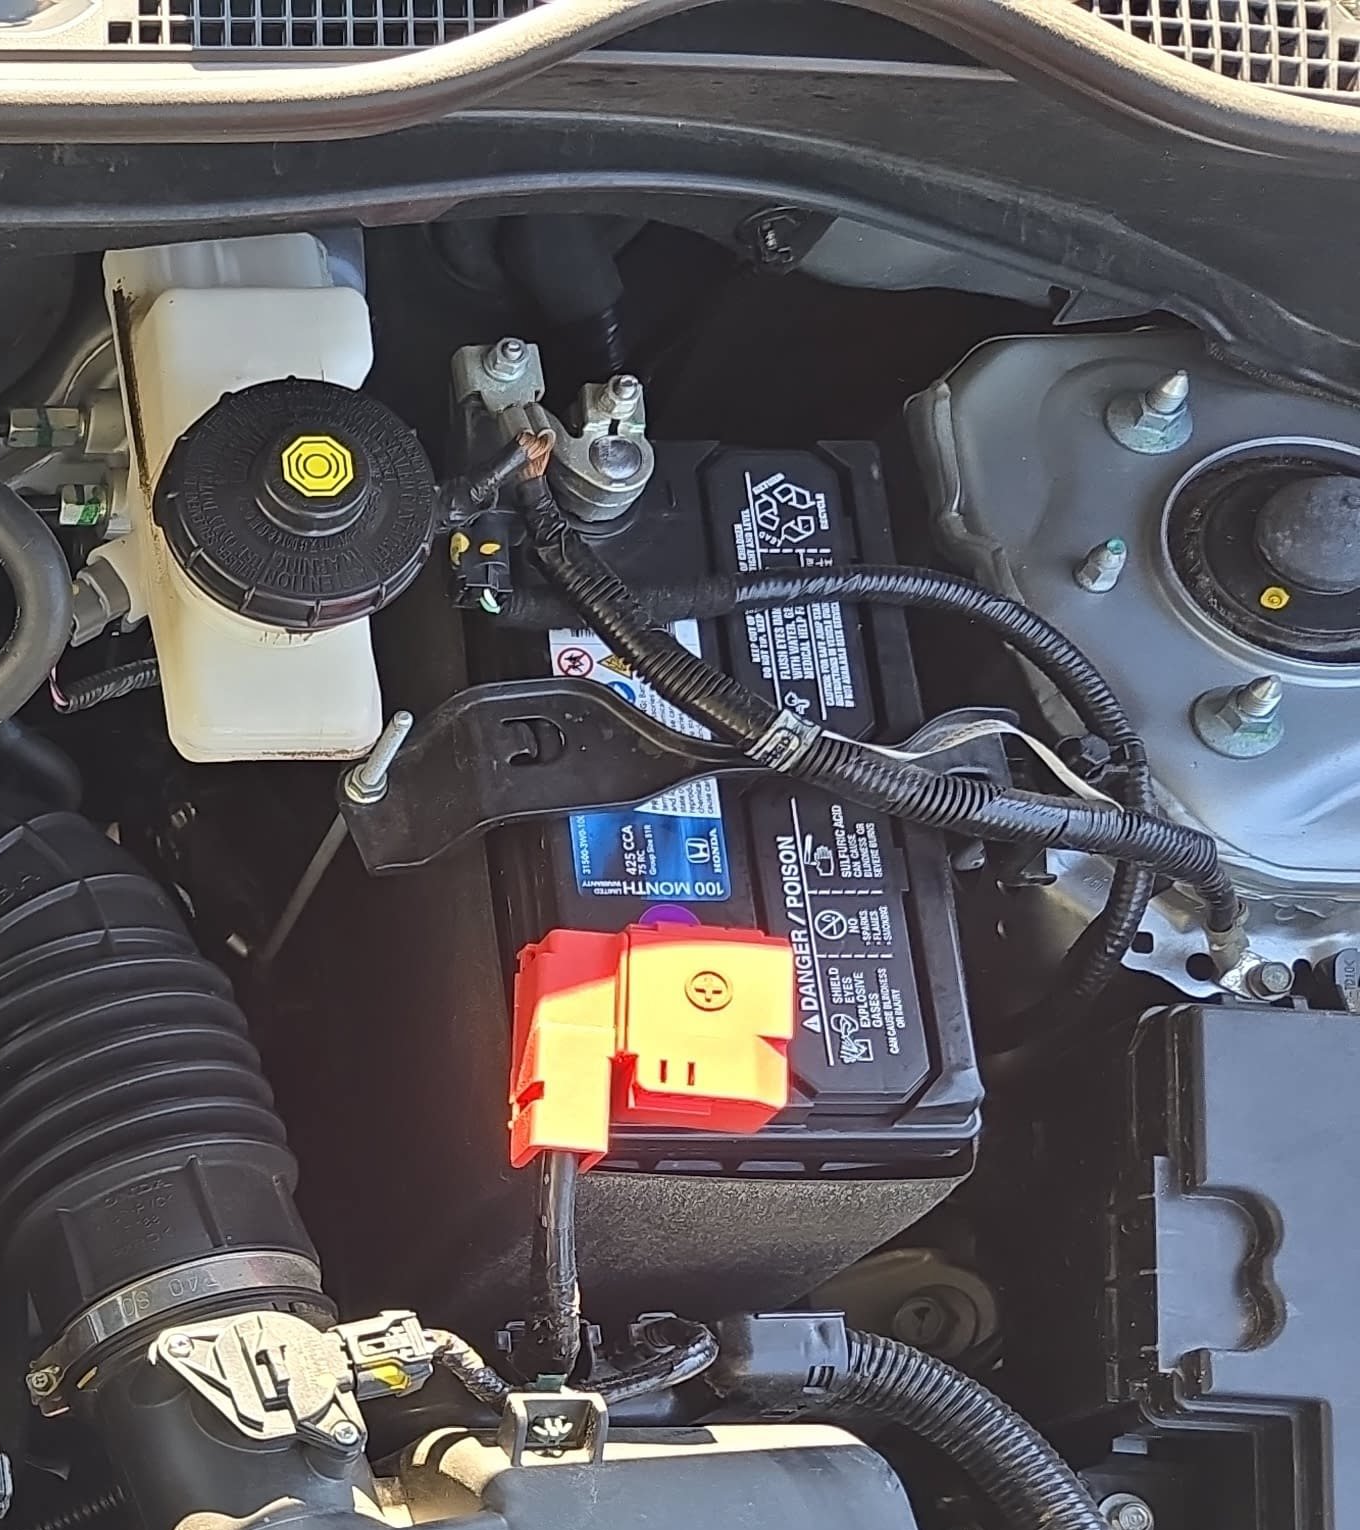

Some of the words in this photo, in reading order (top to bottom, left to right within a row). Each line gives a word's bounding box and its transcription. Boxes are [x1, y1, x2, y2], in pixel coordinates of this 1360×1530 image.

[831, 805, 844, 828] ACID
[621, 825, 635, 848] CCA
[847, 833, 859, 859] CAUSE
[623, 849, 637, 875] 425
[708, 828, 722, 873] HONDA
[835, 829, 852, 878] SULFURIC
[776, 835, 804, 908] POISON
[852, 861, 862, 878] CAN
[622, 881, 690, 895] MONTH
[695, 881, 724, 896] 100
[847, 918, 858, 934] NO
[791, 930, 818, 1010] DANGER
[828, 967, 842, 1004] SHIELD
[842, 977, 855, 1003] EYES
[853, 971, 871, 1027] EXPLOSIVE
[868, 993, 882, 1028] GASES
[884, 1011, 897, 1036] CAUSE
[887, 1037, 900, 1054] CAN
